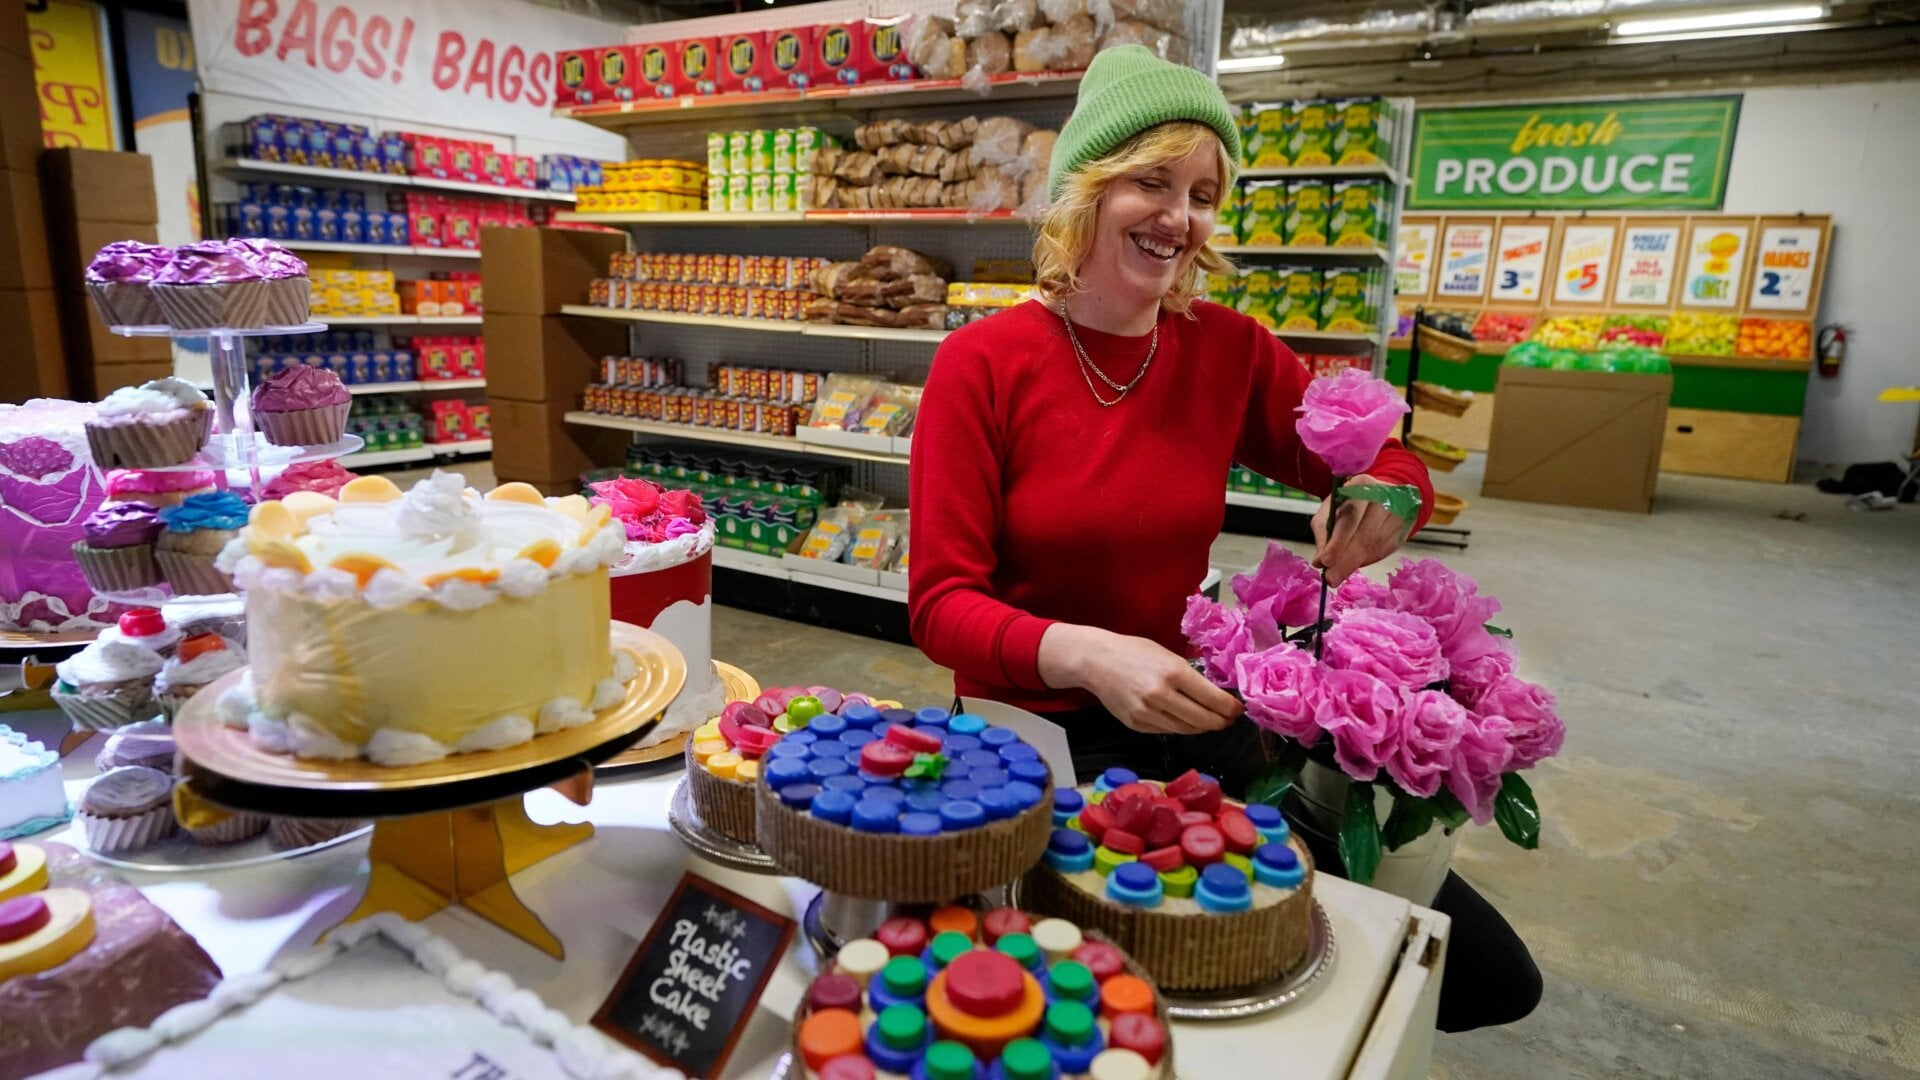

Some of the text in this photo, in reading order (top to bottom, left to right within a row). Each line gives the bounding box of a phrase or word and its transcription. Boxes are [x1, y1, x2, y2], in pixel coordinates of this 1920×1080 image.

[234, 0, 414, 84] BAGS!
[1510, 111, 1622, 155] fresh
[1434, 153, 1694, 195] PRODUCE
[1501, 270, 1519, 290] 3
[1579, 264, 1599, 291] 5
[1760, 272, 1781, 296] 2
[669, 919, 752, 981] Plastic
[663, 949, 727, 1002] Sheet
[649, 977, 711, 1031] Cake
